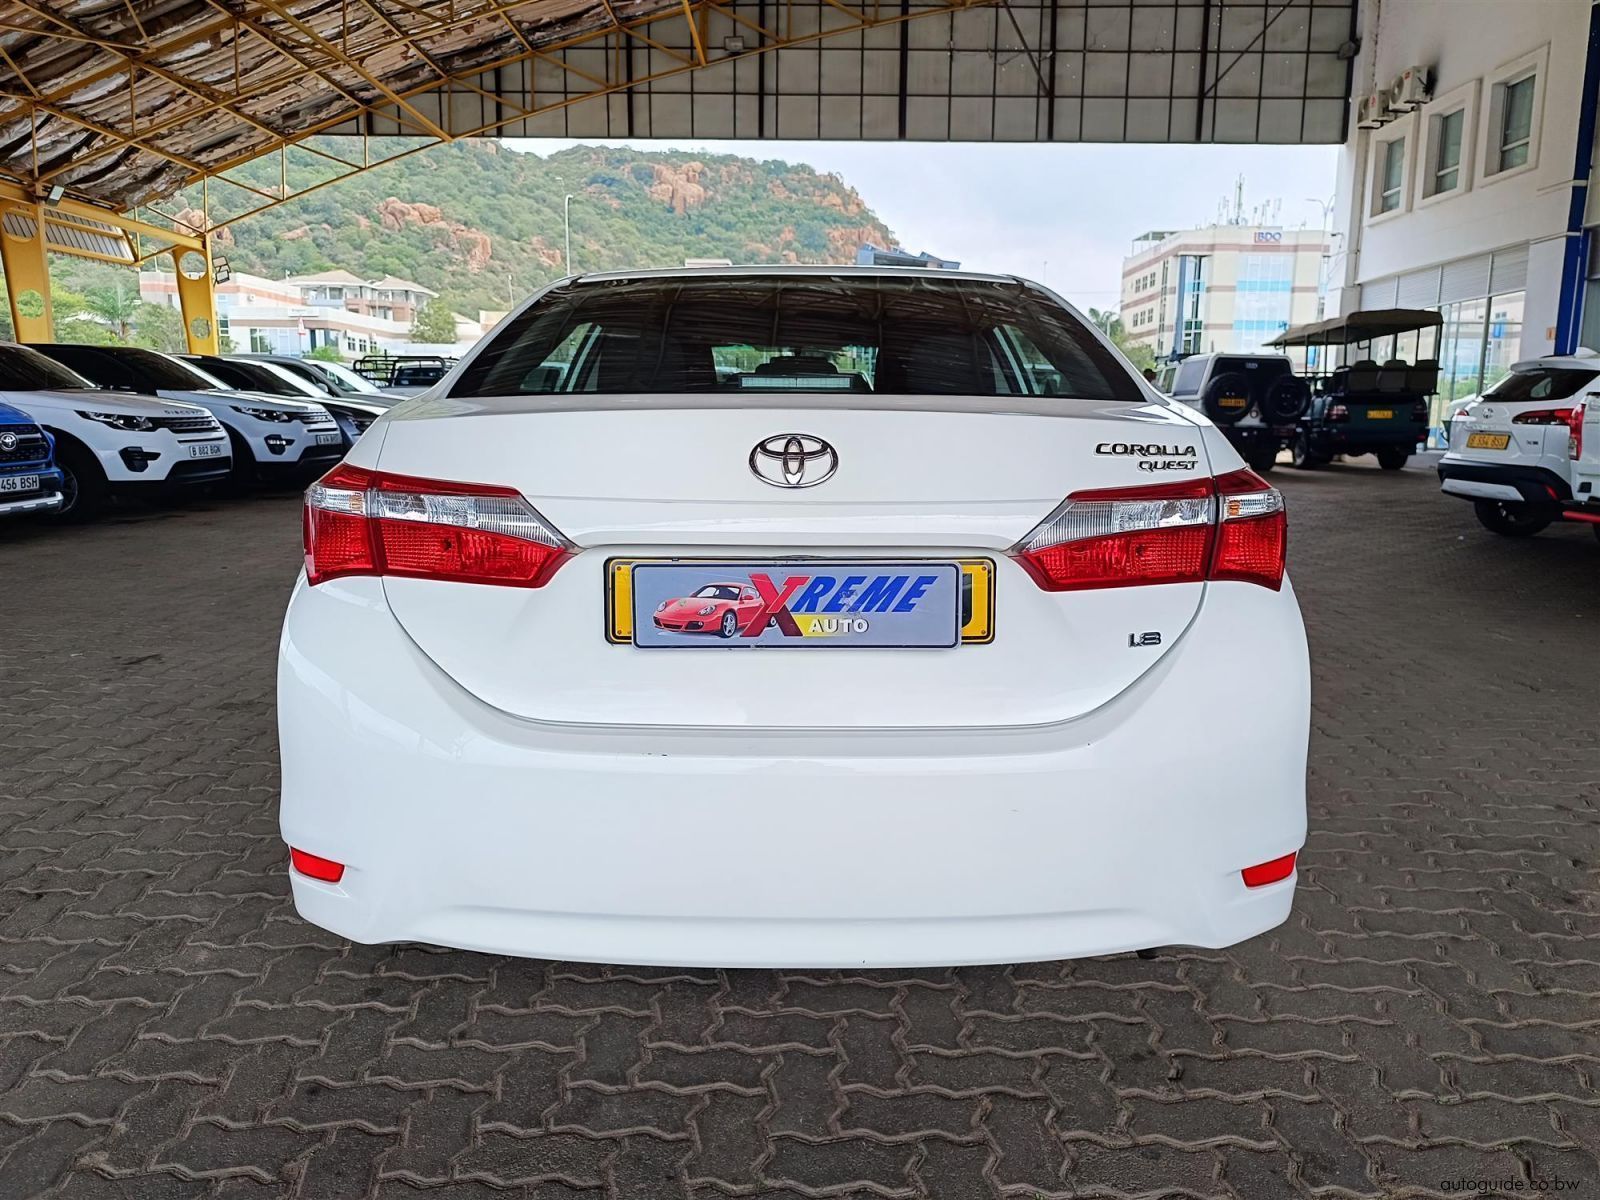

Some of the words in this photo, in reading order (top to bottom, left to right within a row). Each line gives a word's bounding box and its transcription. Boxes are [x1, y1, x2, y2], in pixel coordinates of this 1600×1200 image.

[1257, 231, 1282, 241] BDO
[192, 446, 197, 456] B
[198, 446, 209, 455] 882
[1094, 443, 1197, 456] COROLLA
[1138, 460, 1199, 472] QUEST
[1, 478, 18, 491] 456
[20, 476, 38, 489] BSH
[740, 573, 938, 637] XTREME
[808, 618, 869, 633] AUTO
